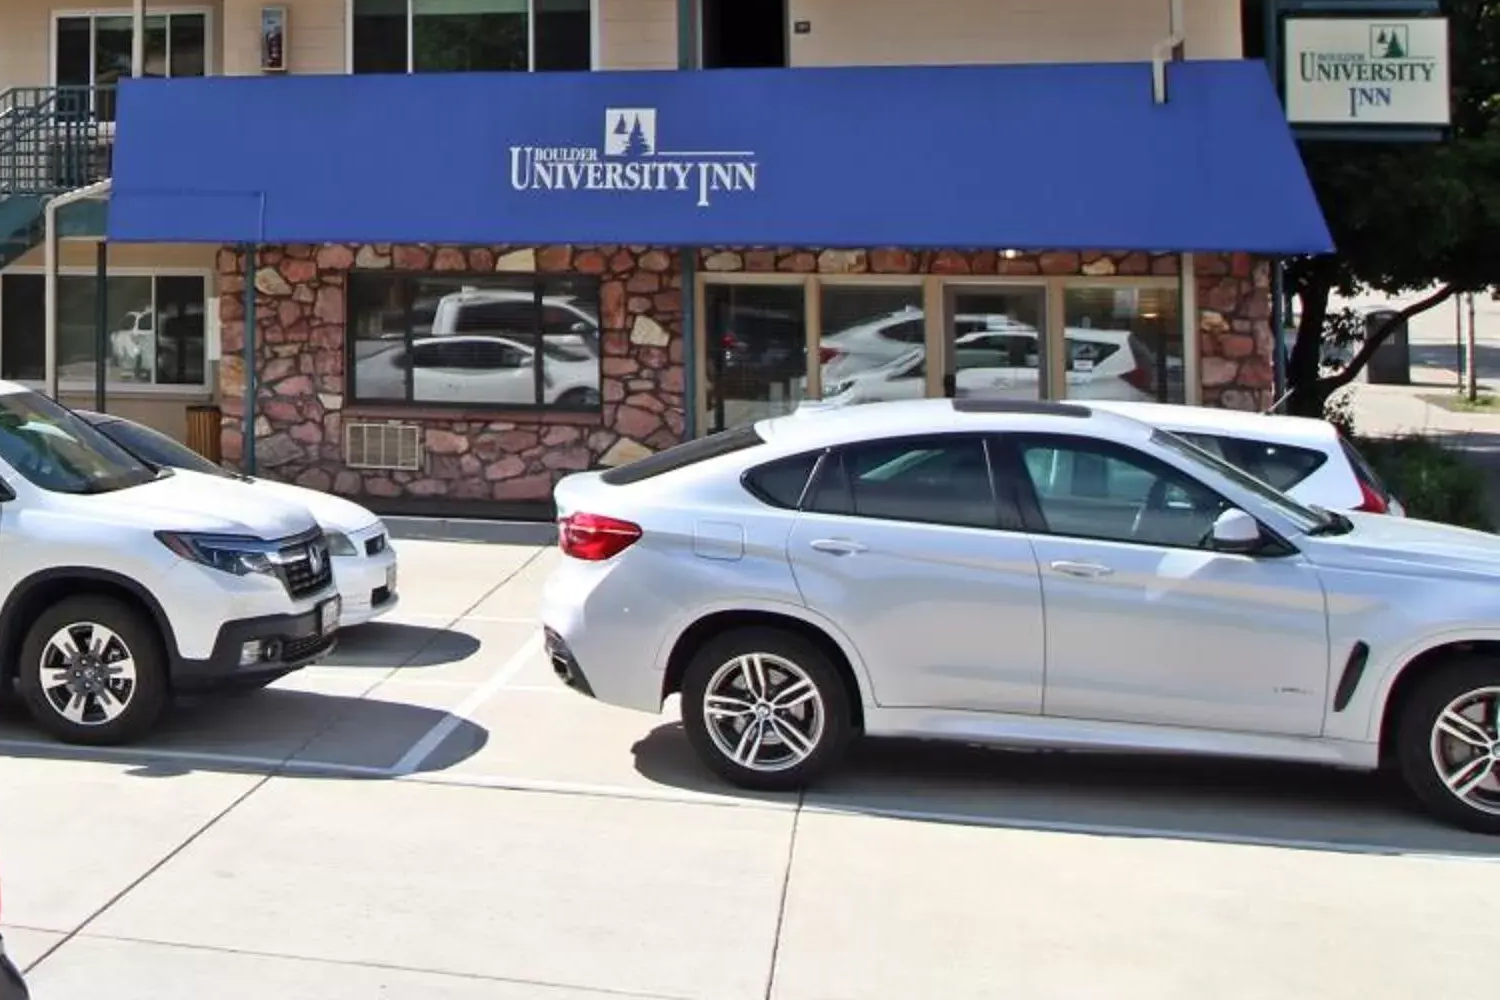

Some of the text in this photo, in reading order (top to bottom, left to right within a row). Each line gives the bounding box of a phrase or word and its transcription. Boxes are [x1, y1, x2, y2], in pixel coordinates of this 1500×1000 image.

[1299, 52, 1435, 82] UNIVERSITY
[1348, 88, 1392, 117] INN
[534, 148, 597, 161] BOULDER
[510, 147, 757, 206] UNIVERSITY INN
